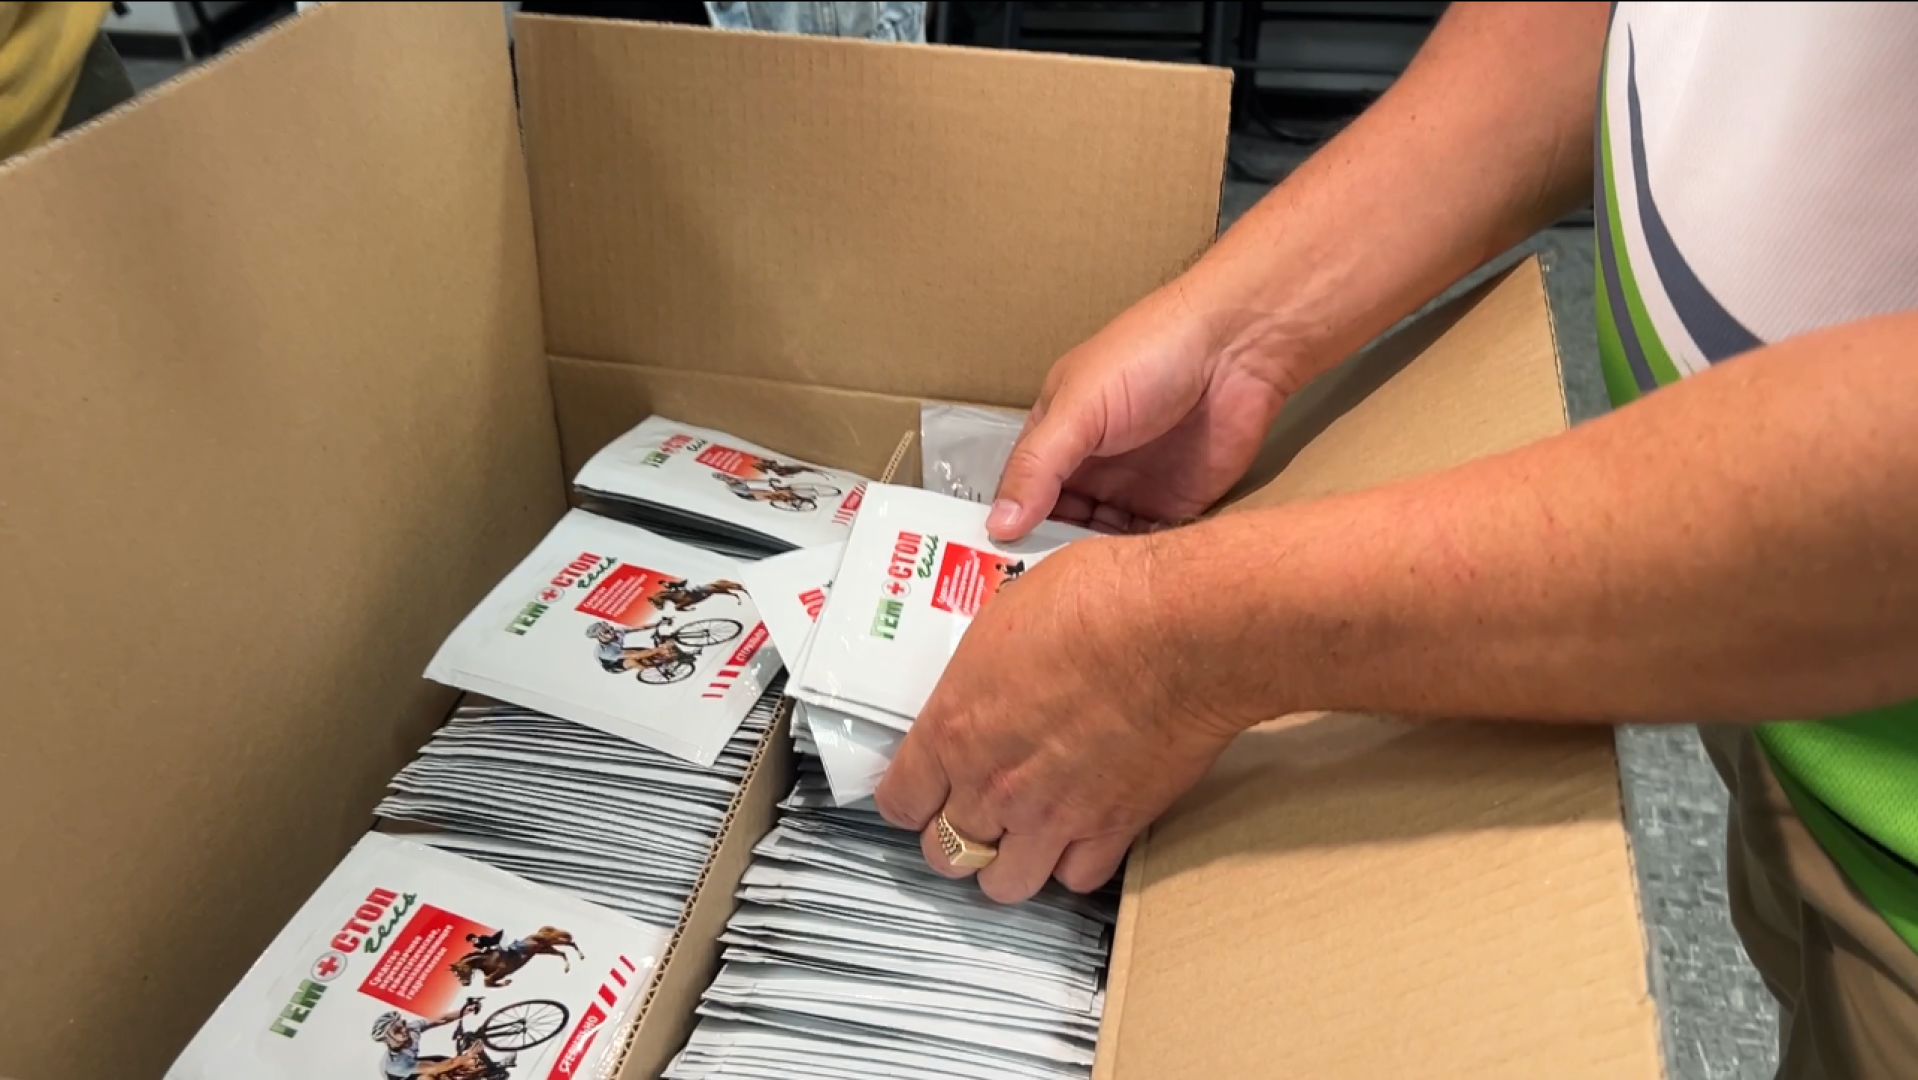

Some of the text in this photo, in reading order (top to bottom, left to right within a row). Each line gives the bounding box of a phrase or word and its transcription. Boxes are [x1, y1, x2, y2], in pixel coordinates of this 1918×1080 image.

[504, 552, 602, 635] ГЕМ СТОП
[869, 531, 922, 640] ГЕМ СТОП
[269, 887, 399, 1038] ГЕМ СТОП
[363, 892, 417, 953] гель
